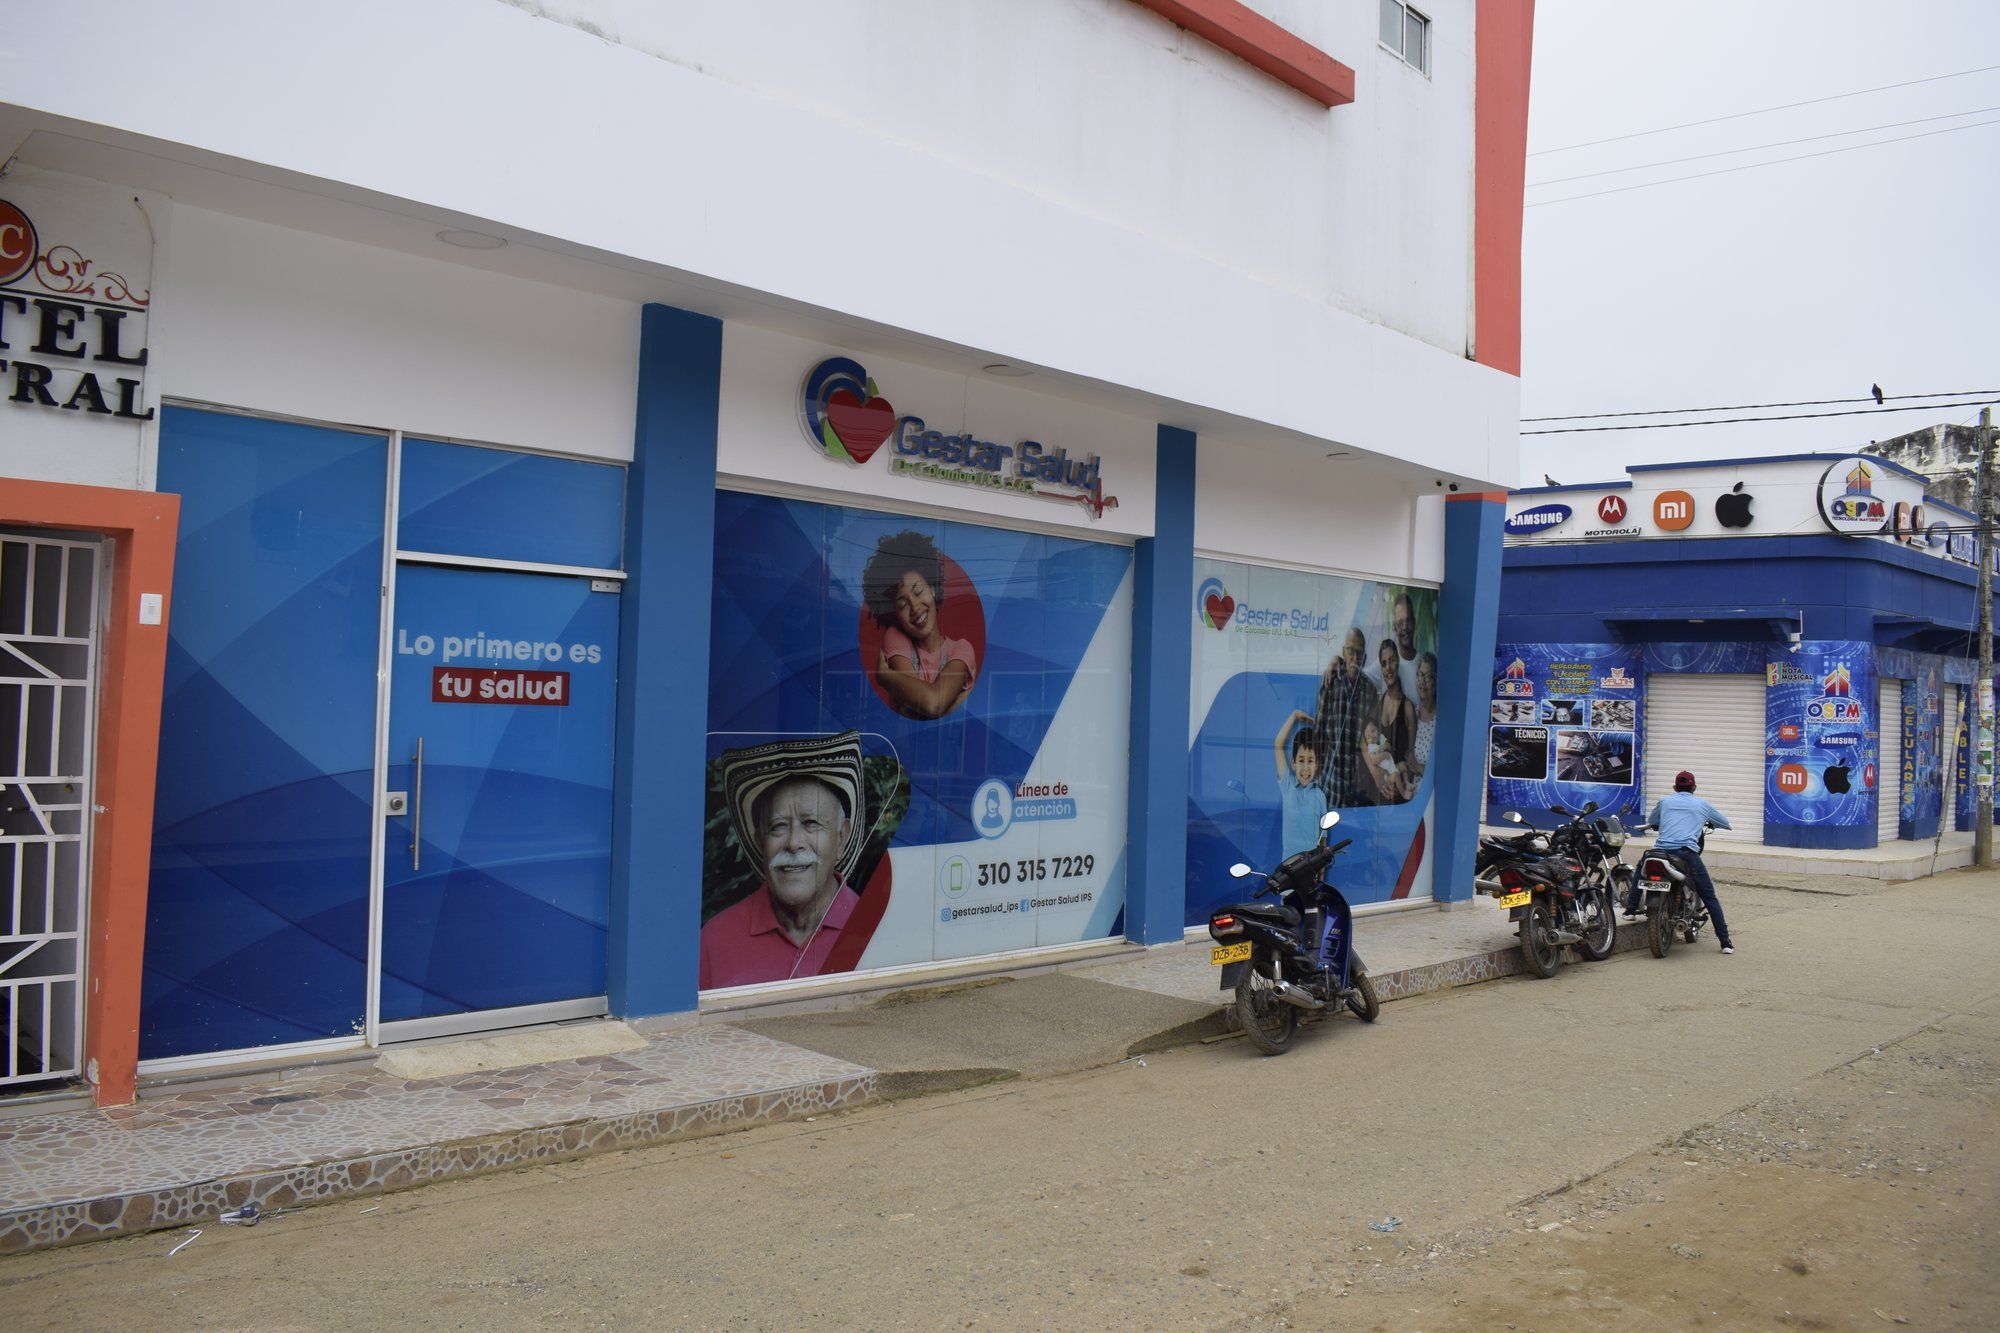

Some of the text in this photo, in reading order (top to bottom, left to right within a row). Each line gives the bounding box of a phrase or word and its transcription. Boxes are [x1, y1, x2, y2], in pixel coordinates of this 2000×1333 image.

[896, 415, 1101, 490] Gestar Salud
[1831, 500, 1886, 517] OSPM
[1510, 511, 1563, 527] SAMSUNG
[1584, 528, 1639, 537] MOTOROLA
[1235, 603, 1329, 632] Gestar Salud
[398, 628, 601, 664] Lo primero es
[438, 672, 562, 700] tu salud
[1497, 682, 1533, 694] OSPM
[1807, 702, 1860, 718] OSPM
[1515, 727, 1547, 739] TÉCNICOS
[1820, 736, 1858, 745] SAMSUNG
[1052, 781, 1069, 796] de
[1015, 801, 1071, 818] atención
[978, 854, 1095, 887] 310 315 7229
[952, 892, 1092, 920] gestarsalud_ips Gestar Salud IPS
